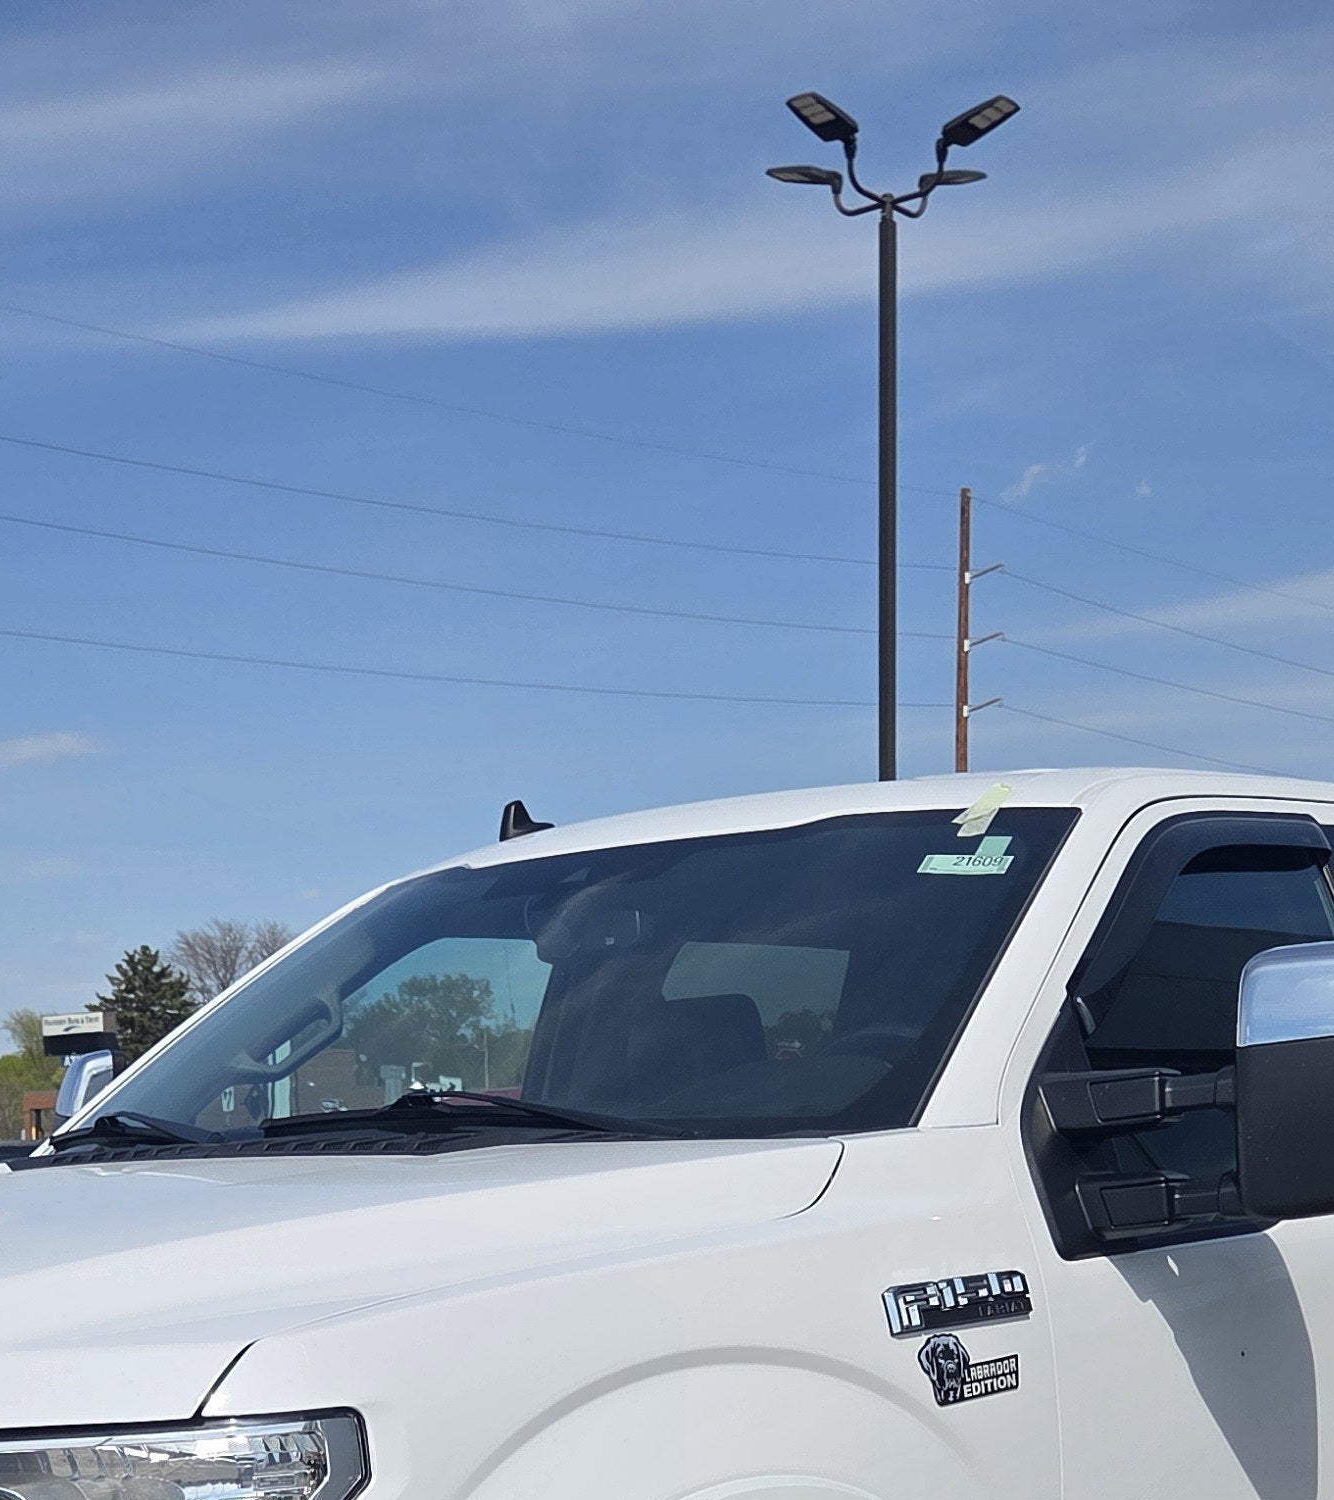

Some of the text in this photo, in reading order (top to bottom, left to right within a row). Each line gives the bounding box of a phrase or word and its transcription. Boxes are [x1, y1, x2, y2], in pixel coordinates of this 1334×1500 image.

[952, 856, 1004, 867] 21609
[964, 1357, 1017, 1383] LABRADOR
[962, 1374, 1017, 1399] EDITION
